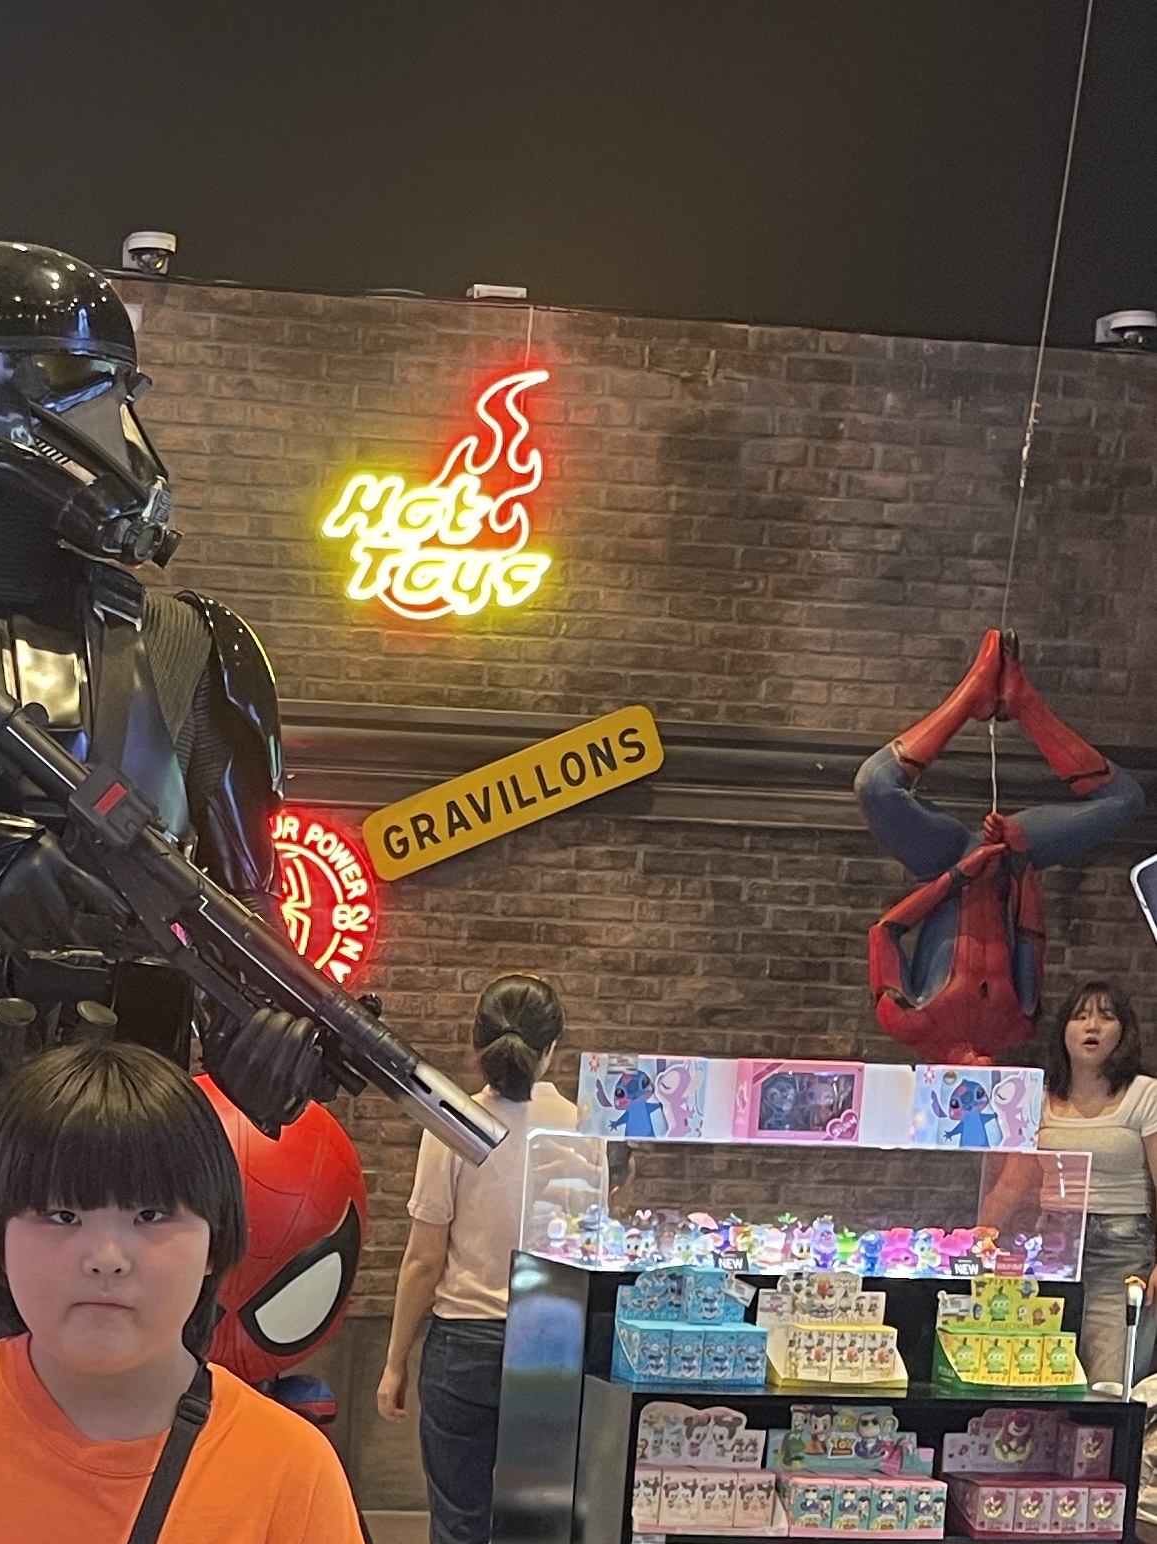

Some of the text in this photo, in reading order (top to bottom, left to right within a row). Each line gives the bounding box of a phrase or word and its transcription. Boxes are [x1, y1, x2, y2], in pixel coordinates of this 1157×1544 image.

[321, 473, 493, 545] Hot
[346, 537, 552, 616] Toys
[382, 728, 646, 861] GRAVILLONS
[304, 823, 368, 900] POWER
[328, 936, 364, 984] AN
[718, 1257, 744, 1270] NEW
[954, 1263, 979, 1275] NEW
